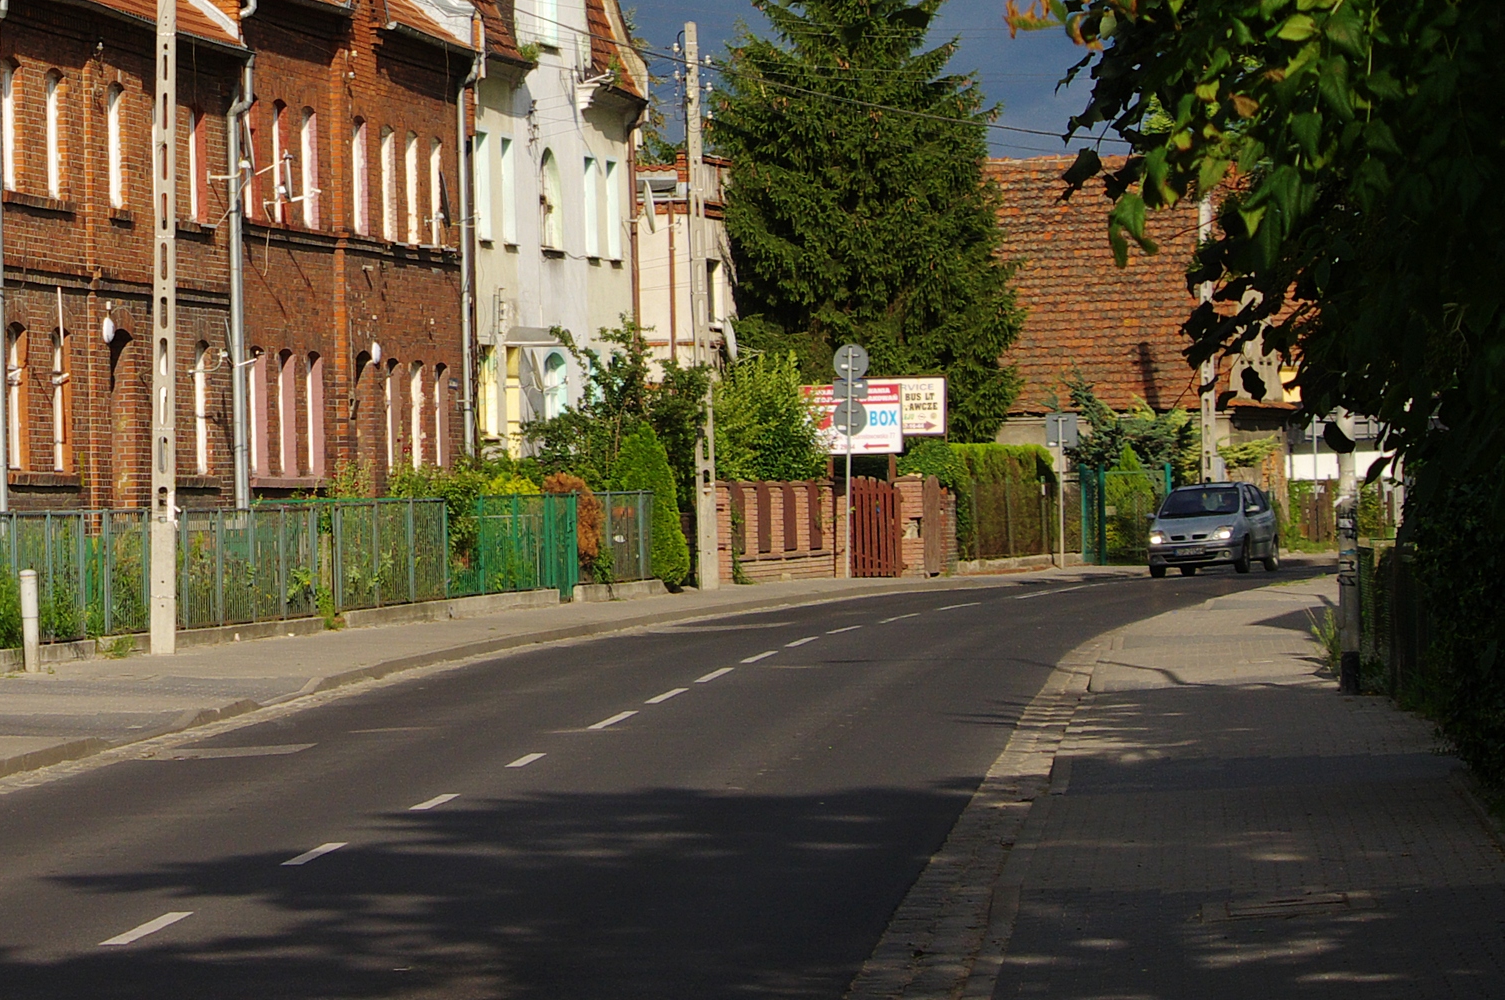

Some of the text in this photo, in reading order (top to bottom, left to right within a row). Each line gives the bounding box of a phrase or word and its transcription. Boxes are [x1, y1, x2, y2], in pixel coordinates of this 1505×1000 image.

[905, 393, 934, 401] BUS LT
[905, 402, 938, 411] AWCZE
[869, 410, 898, 426] BOX
